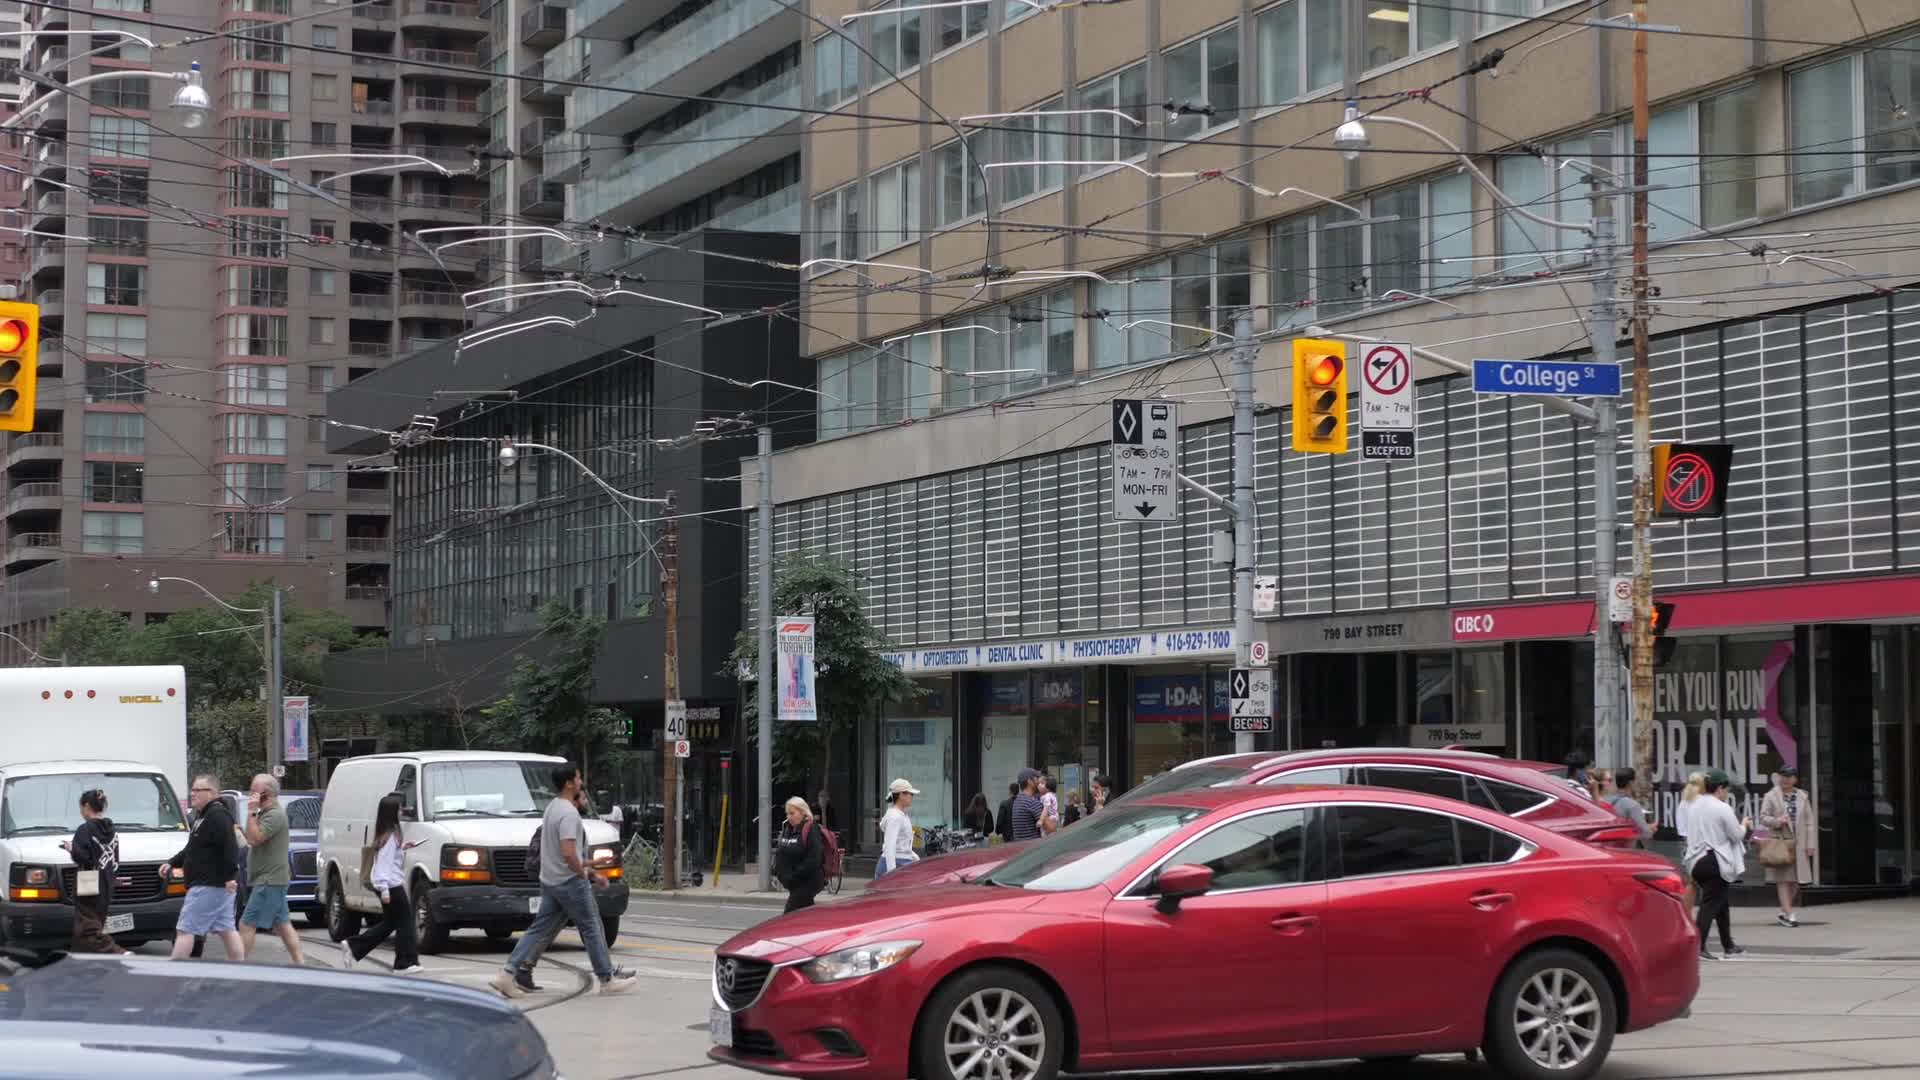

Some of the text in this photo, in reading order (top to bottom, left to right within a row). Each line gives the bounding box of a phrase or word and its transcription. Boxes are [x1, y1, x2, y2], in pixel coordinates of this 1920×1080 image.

[1500, 363, 1596, 392] College St
[1379, 434, 1398, 444] TTC
[1365, 446, 1412, 456] EXCEPTED
[1123, 483, 1168, 496] MON-FRI
[1323, 623, 1404, 641] 790 BAY STREET
[1455, 615, 1481, 633] CIBC
[780, 642, 812, 654] TORONTO
[923, 649, 968, 667] OPTOMETRISTS
[988, 645, 1017, 663] DENTAL
[1019, 643, 1043, 661] CLINIC
[1073, 636, 1141, 658] PHYSIOTHERAPY
[1166, 630, 1230, 651] 416-929-1900
[1655, 670, 1766, 713] EN YOU RUN
[668, 717, 685, 735] 40
[1234, 718, 1269, 730] BEGINS
[1444, 728, 1458, 742] Bay
[1460, 728, 1481, 740] Street
[1652, 717, 1769, 785] OR ONE
